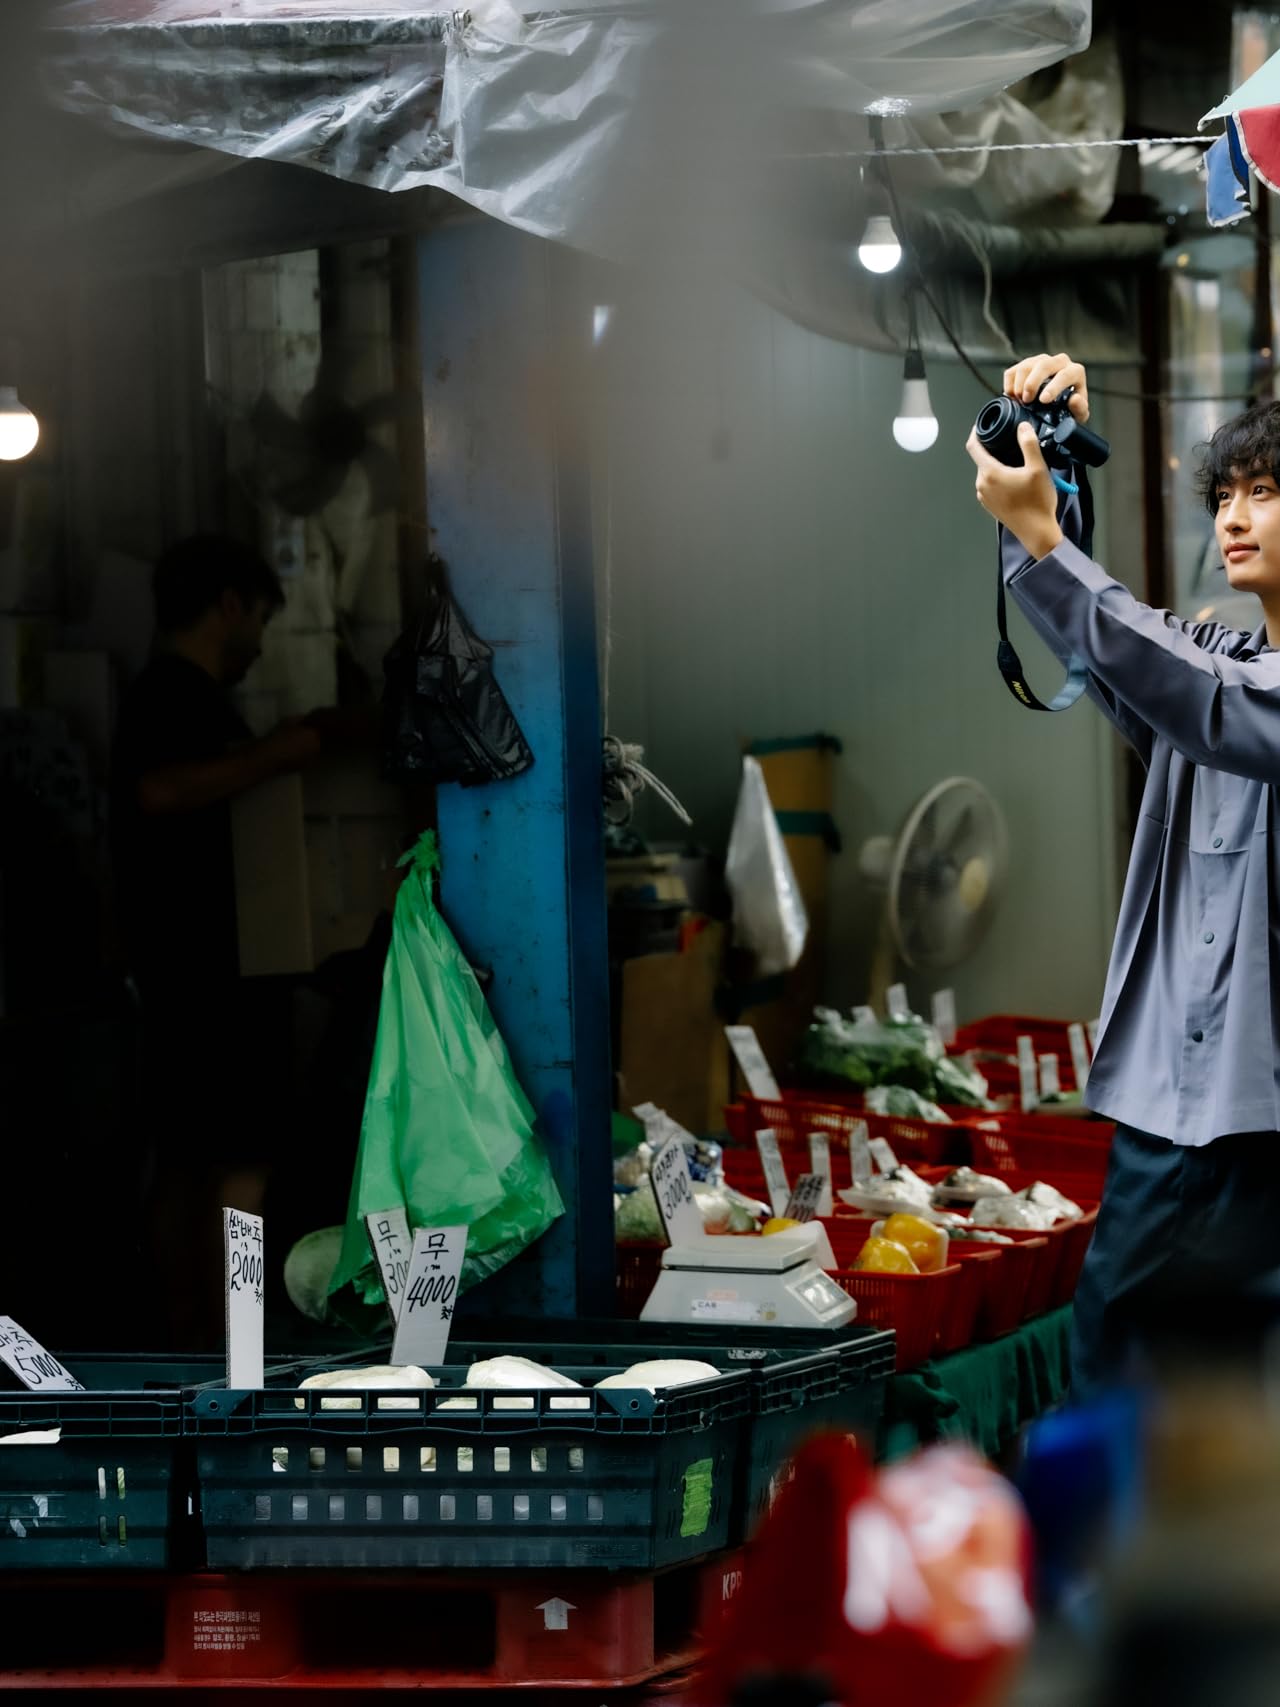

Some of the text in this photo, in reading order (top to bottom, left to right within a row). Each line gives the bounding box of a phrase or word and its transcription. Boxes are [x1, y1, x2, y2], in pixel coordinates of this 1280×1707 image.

[377, 1220, 398, 1247] 무
[420, 1233, 449, 1260] 무
[231, 1251, 262, 1291] 2000
[407, 1275, 456, 1312] 4000
[14, 1353, 63, 1384] 5000
